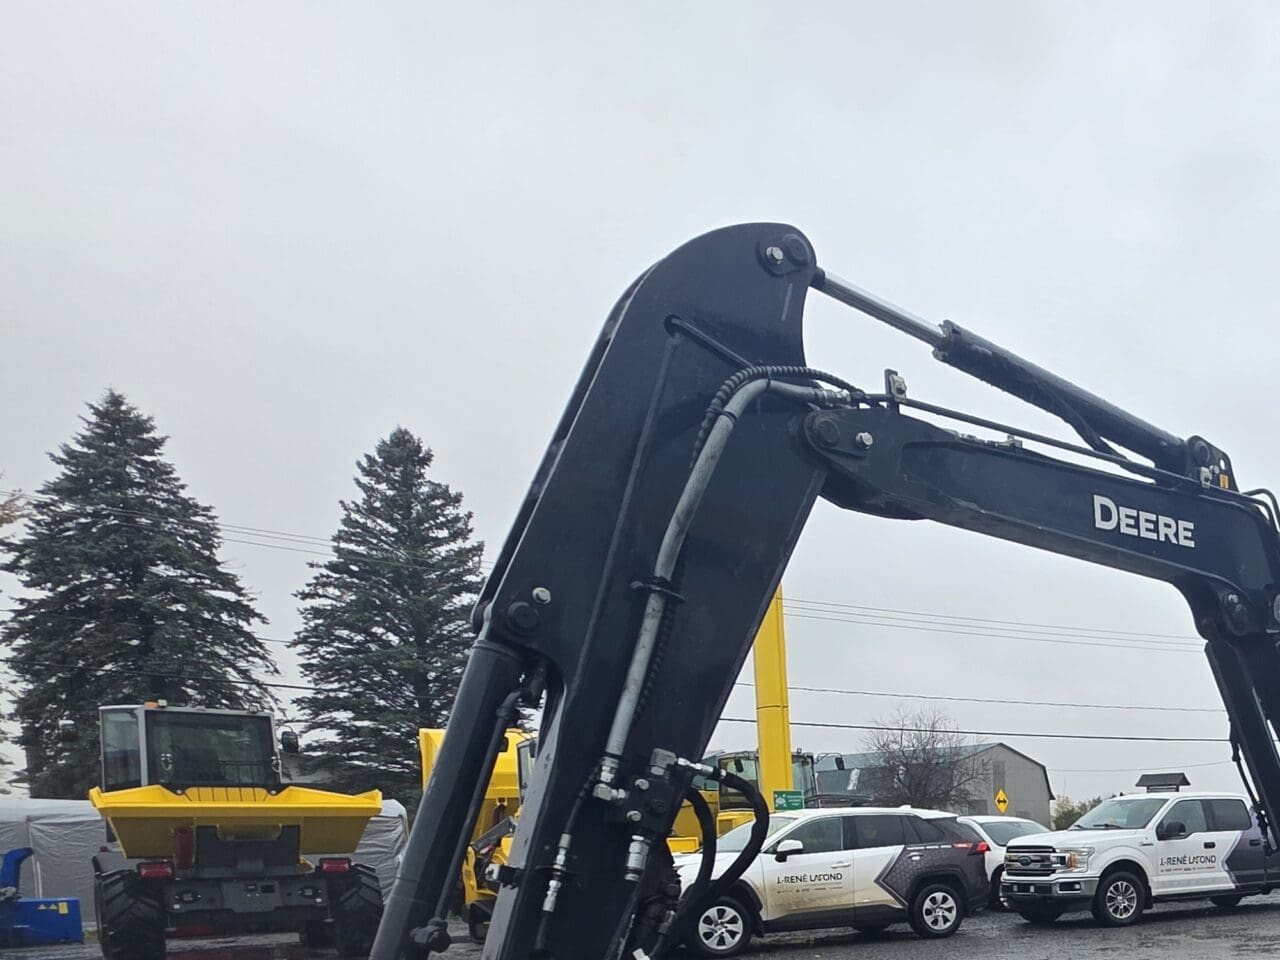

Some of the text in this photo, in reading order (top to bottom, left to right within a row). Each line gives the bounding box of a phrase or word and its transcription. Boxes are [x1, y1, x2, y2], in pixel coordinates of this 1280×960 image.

[1093, 494, 1196, 548] DEERE
[1188, 854, 1217, 865] LAFOND
[809, 872, 843, 882] LAFOND
